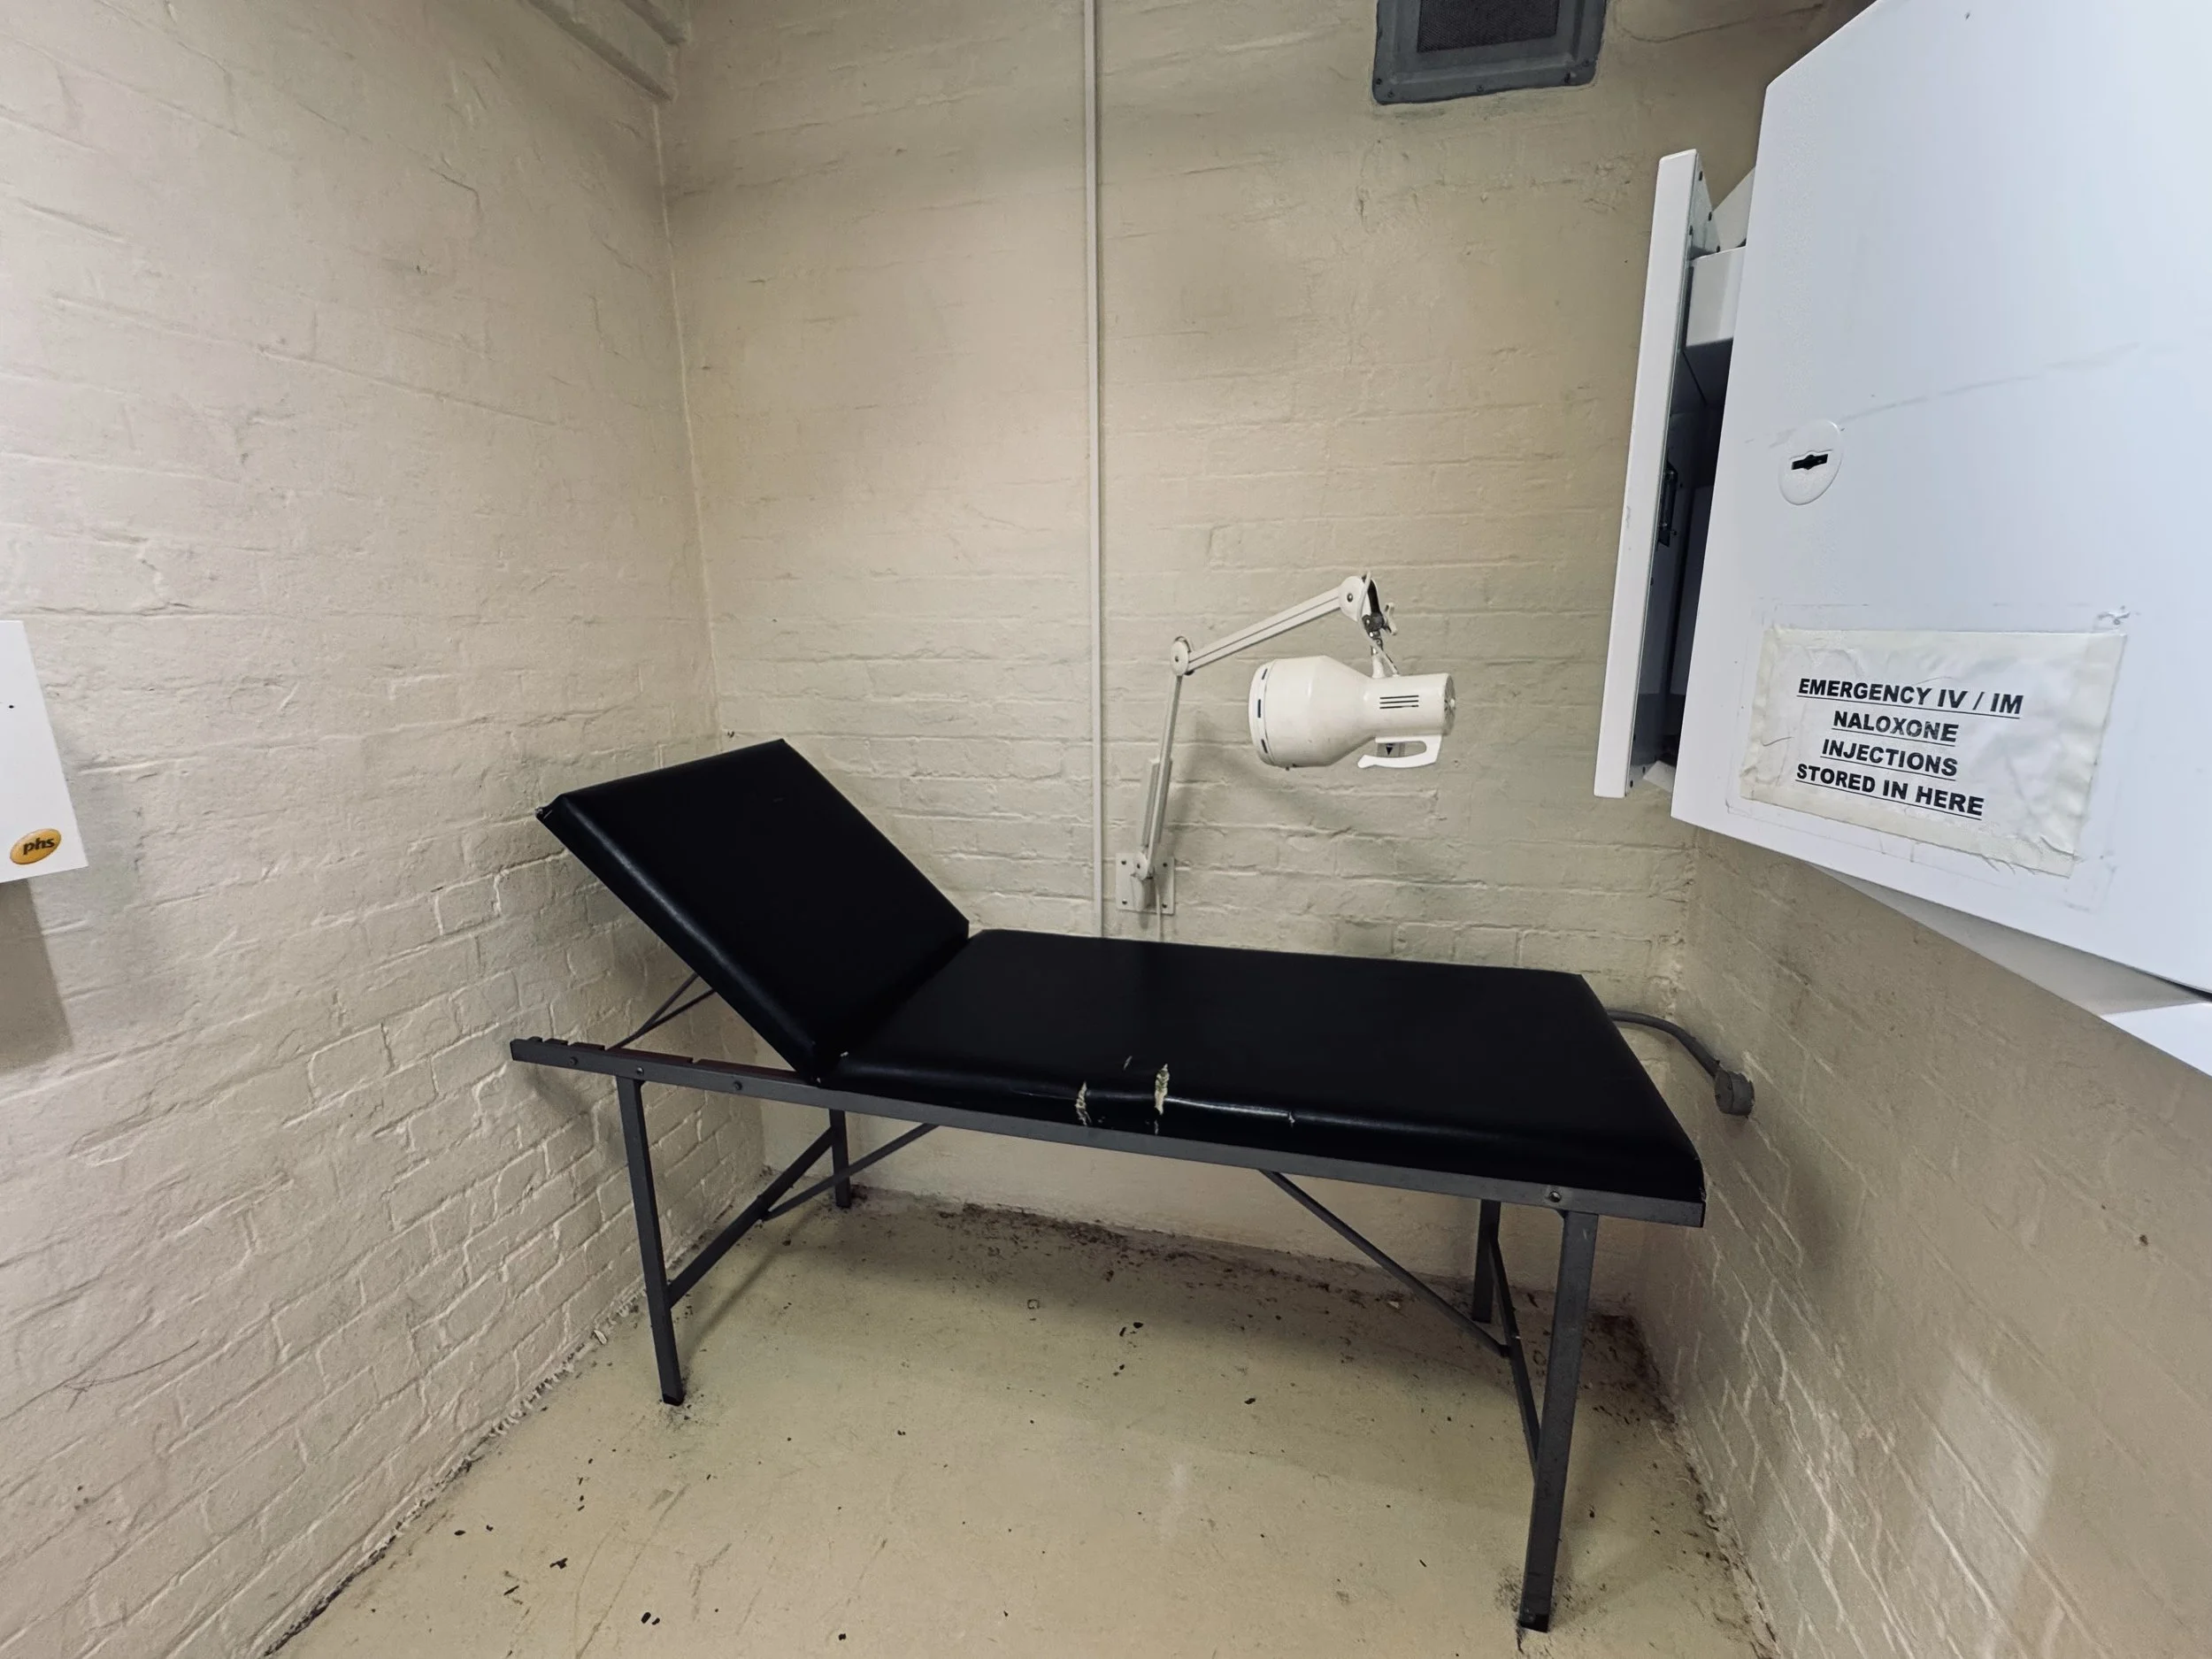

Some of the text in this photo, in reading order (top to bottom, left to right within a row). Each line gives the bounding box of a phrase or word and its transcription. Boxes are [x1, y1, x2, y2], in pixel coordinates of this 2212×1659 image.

[1798, 678, 1932, 705] EMERGENCY
[1938, 689, 1968, 709] IV
[1991, 694, 2024, 715] IM
[1833, 710, 1959, 742] NALOXONE
[1822, 739, 1958, 776] INJECTIONS
[1797, 764, 1984, 816] STORED IN HERE
[23, 837, 55, 856] phs
